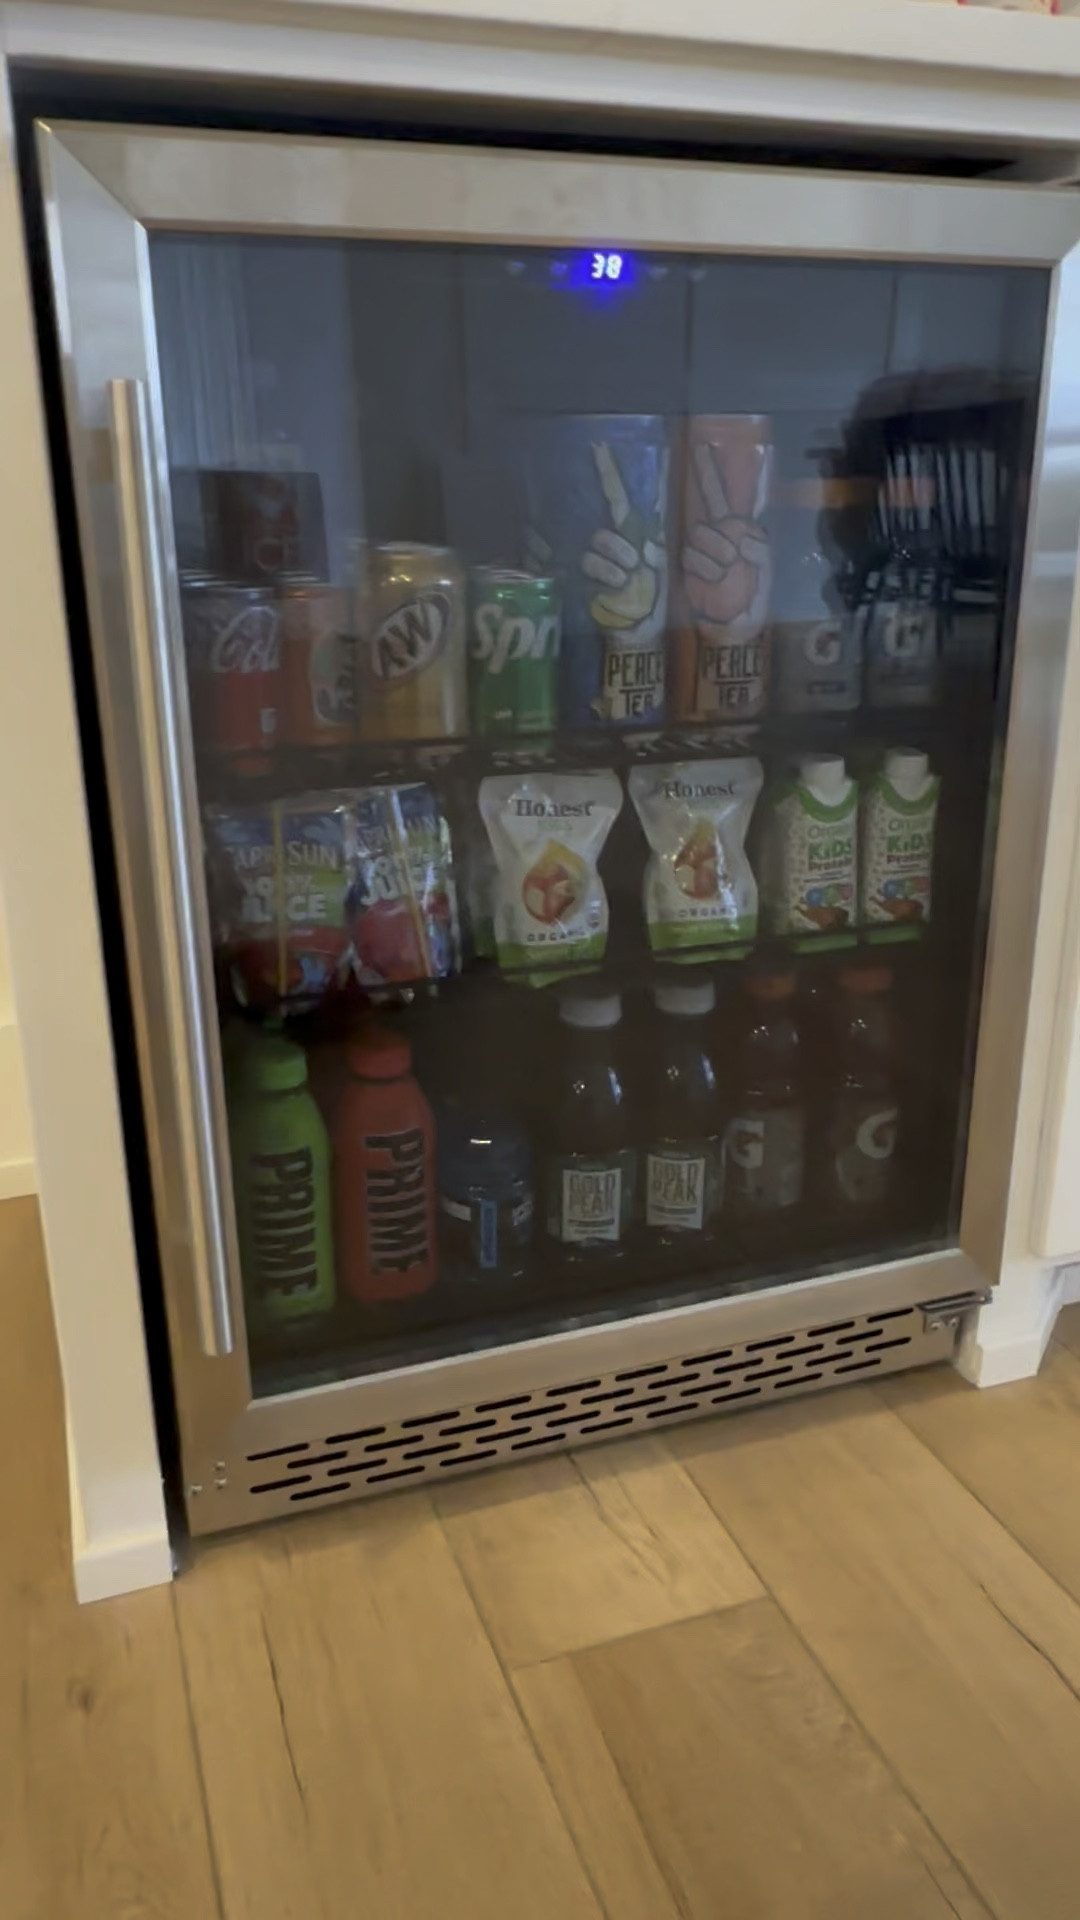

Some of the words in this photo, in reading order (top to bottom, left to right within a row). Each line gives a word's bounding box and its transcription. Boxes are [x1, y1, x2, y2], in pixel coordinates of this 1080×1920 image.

[591, 252, 622, 279] 38
[806, 620, 843, 665] G
[664, 779, 738, 799] Honest
[514, 798, 596, 817] Honest
[286, 841, 338, 870] SUN
[726, 1117, 764, 1170] G
[365, 1128, 427, 1276] PRIME
[653, 1180, 698, 1202] PEAK
[250, 1147, 317, 1298] PRIME
